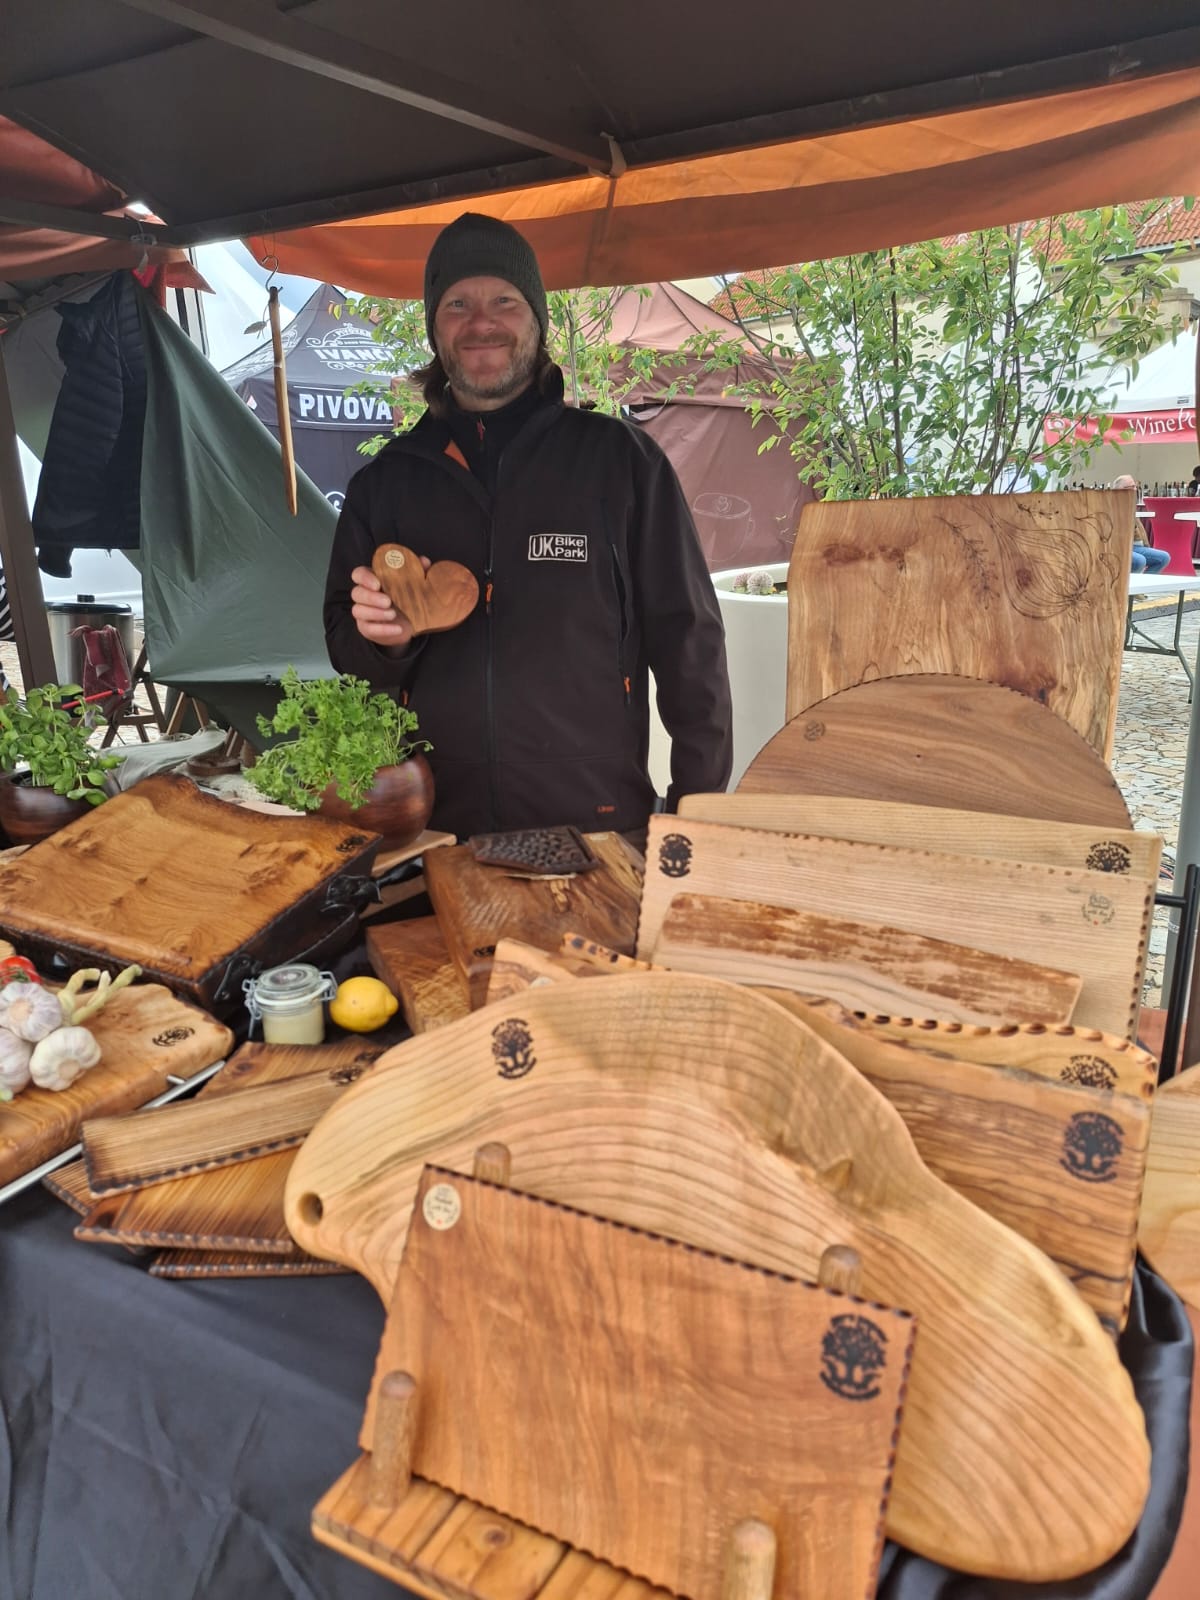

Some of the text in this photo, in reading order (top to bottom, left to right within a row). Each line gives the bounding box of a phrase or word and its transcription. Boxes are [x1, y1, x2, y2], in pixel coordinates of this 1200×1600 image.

[299, 393, 393, 420] PIVOVA
[1127, 408, 1197, 437] WinePo
[532, 536, 555, 557] UK
[555, 536, 585, 547] Bike
[555, 547, 585, 558] Park
